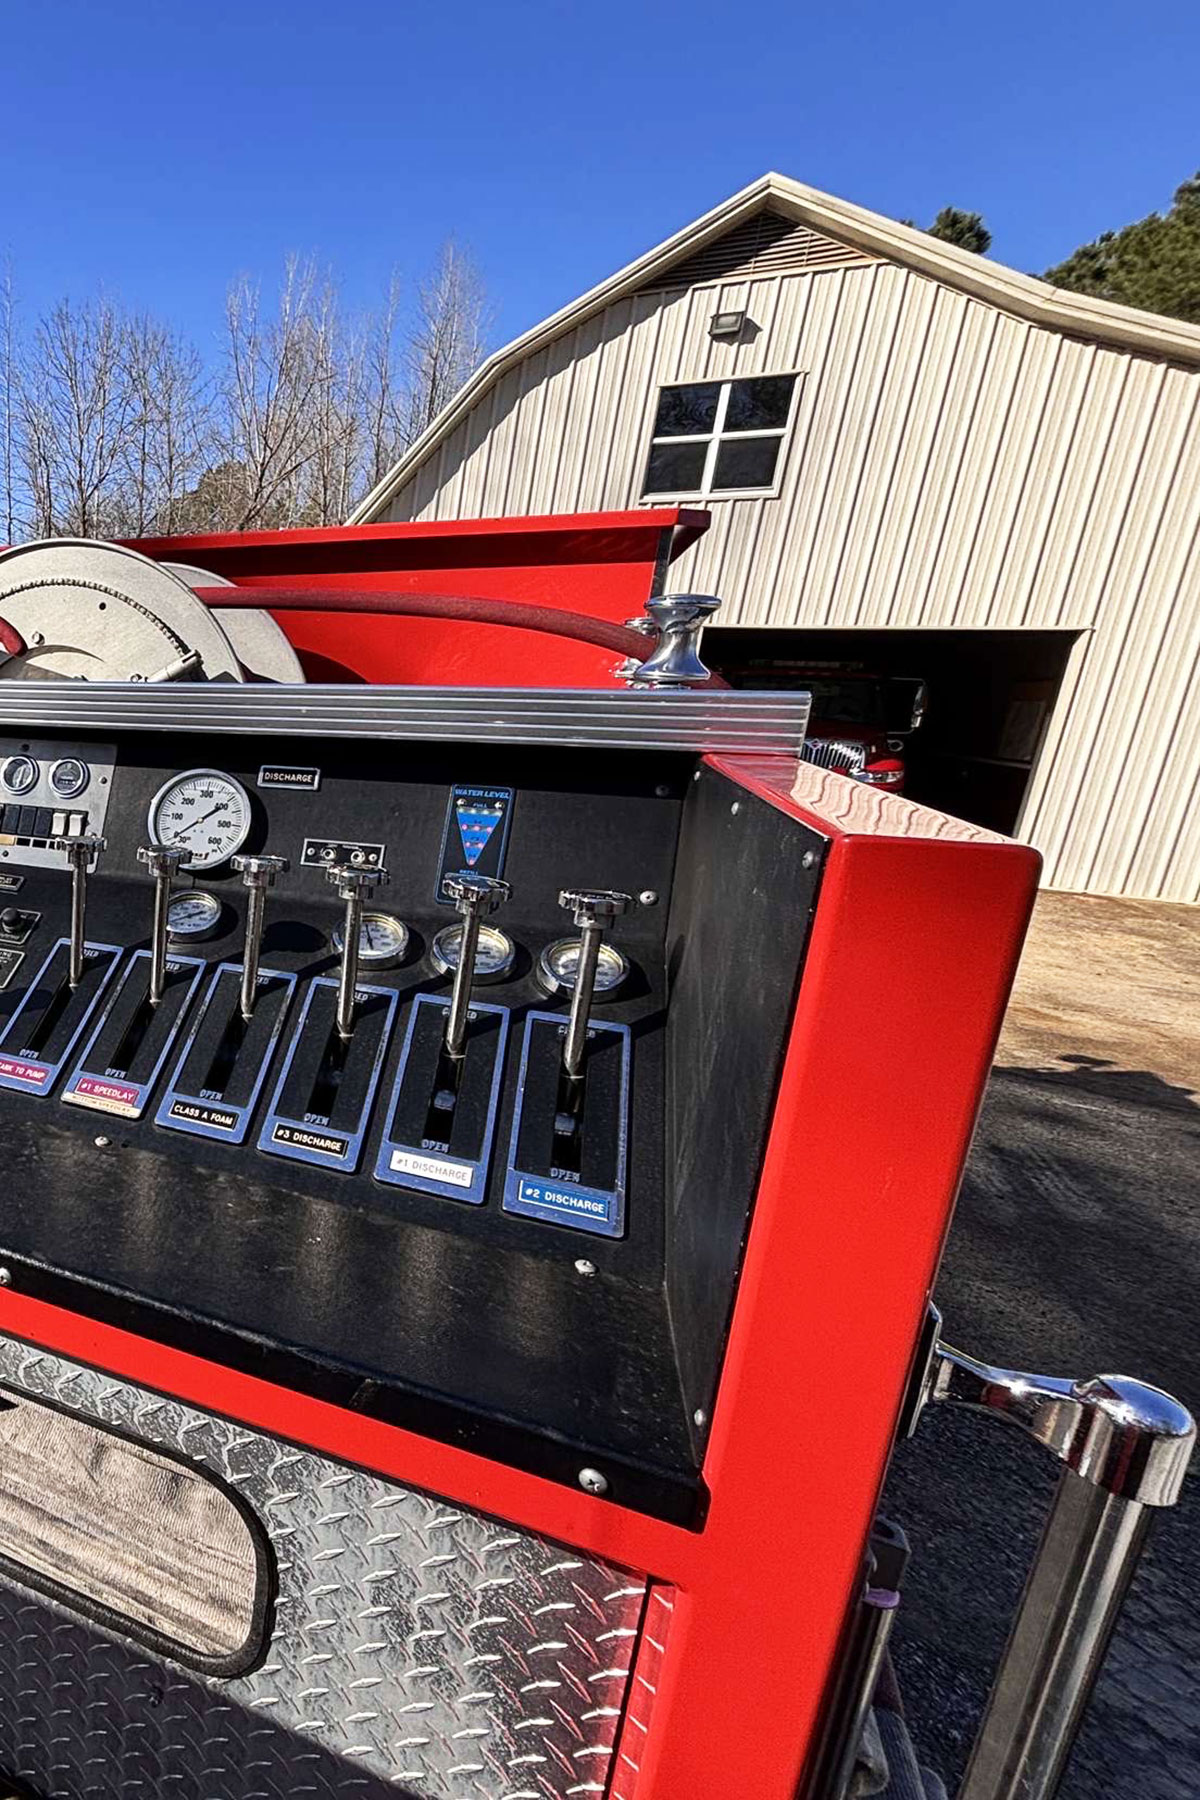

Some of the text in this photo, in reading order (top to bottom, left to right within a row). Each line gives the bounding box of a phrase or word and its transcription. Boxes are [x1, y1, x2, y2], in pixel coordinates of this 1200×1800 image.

[264, 771, 313, 783] DISCHARGE
[200, 790, 213, 799] 300
[455, 788, 510, 799] WATER LEVEL
[181, 797, 195, 806] 200
[215, 802, 229, 811] 400
[171, 812, 184, 820] 100
[217, 820, 232, 829] 500
[208, 836, 222, 845] 600
[19, 1048, 40, 1059] OPEN
[15, 1066, 25, 1074] TO
[25, 1068, 46, 1079] PUMP
[104, 1067, 127, 1079] OPEN
[81, 1082, 134, 1100] #1 SPEEDLAY
[200, 1089, 223, 1101] OPEN
[174, 1104, 233, 1125] CLASS A FOAM
[303, 1112, 330, 1126] OPEN
[277, 1129, 342, 1151] #3 DISCHARGE
[421, 1138, 450, 1153] OPEN
[397, 1158, 468, 1181] #1 DISCHARGE
[550, 1167, 581, 1183] OPEN
[525, 1188, 605, 1214] #2 DISCHARGE
